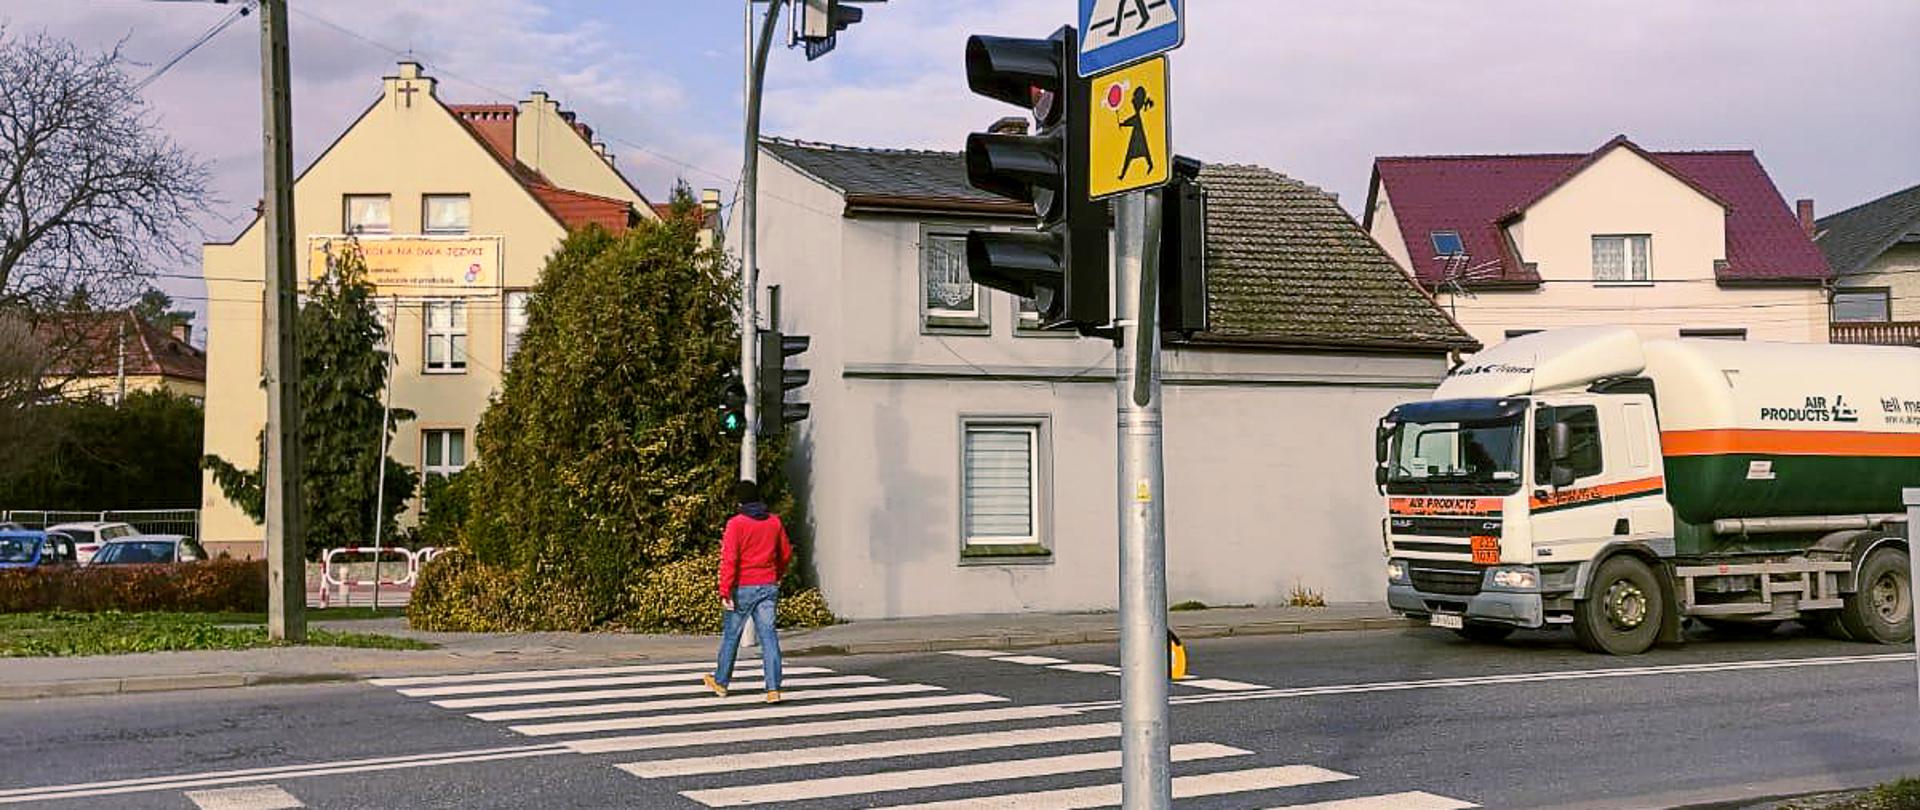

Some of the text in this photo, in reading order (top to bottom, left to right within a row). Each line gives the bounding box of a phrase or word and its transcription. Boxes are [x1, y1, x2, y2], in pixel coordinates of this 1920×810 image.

[354, 247, 393, 256] KOŁA
[397, 247, 412, 256] NA
[416, 247, 442, 256] DWA
[1804, 396, 1827, 409] AIR
[1880, 397, 1901, 412] tell
[1761, 407, 1830, 422] PRODUCTS
[1409, 499, 1477, 510] AIR PRODUCTS
